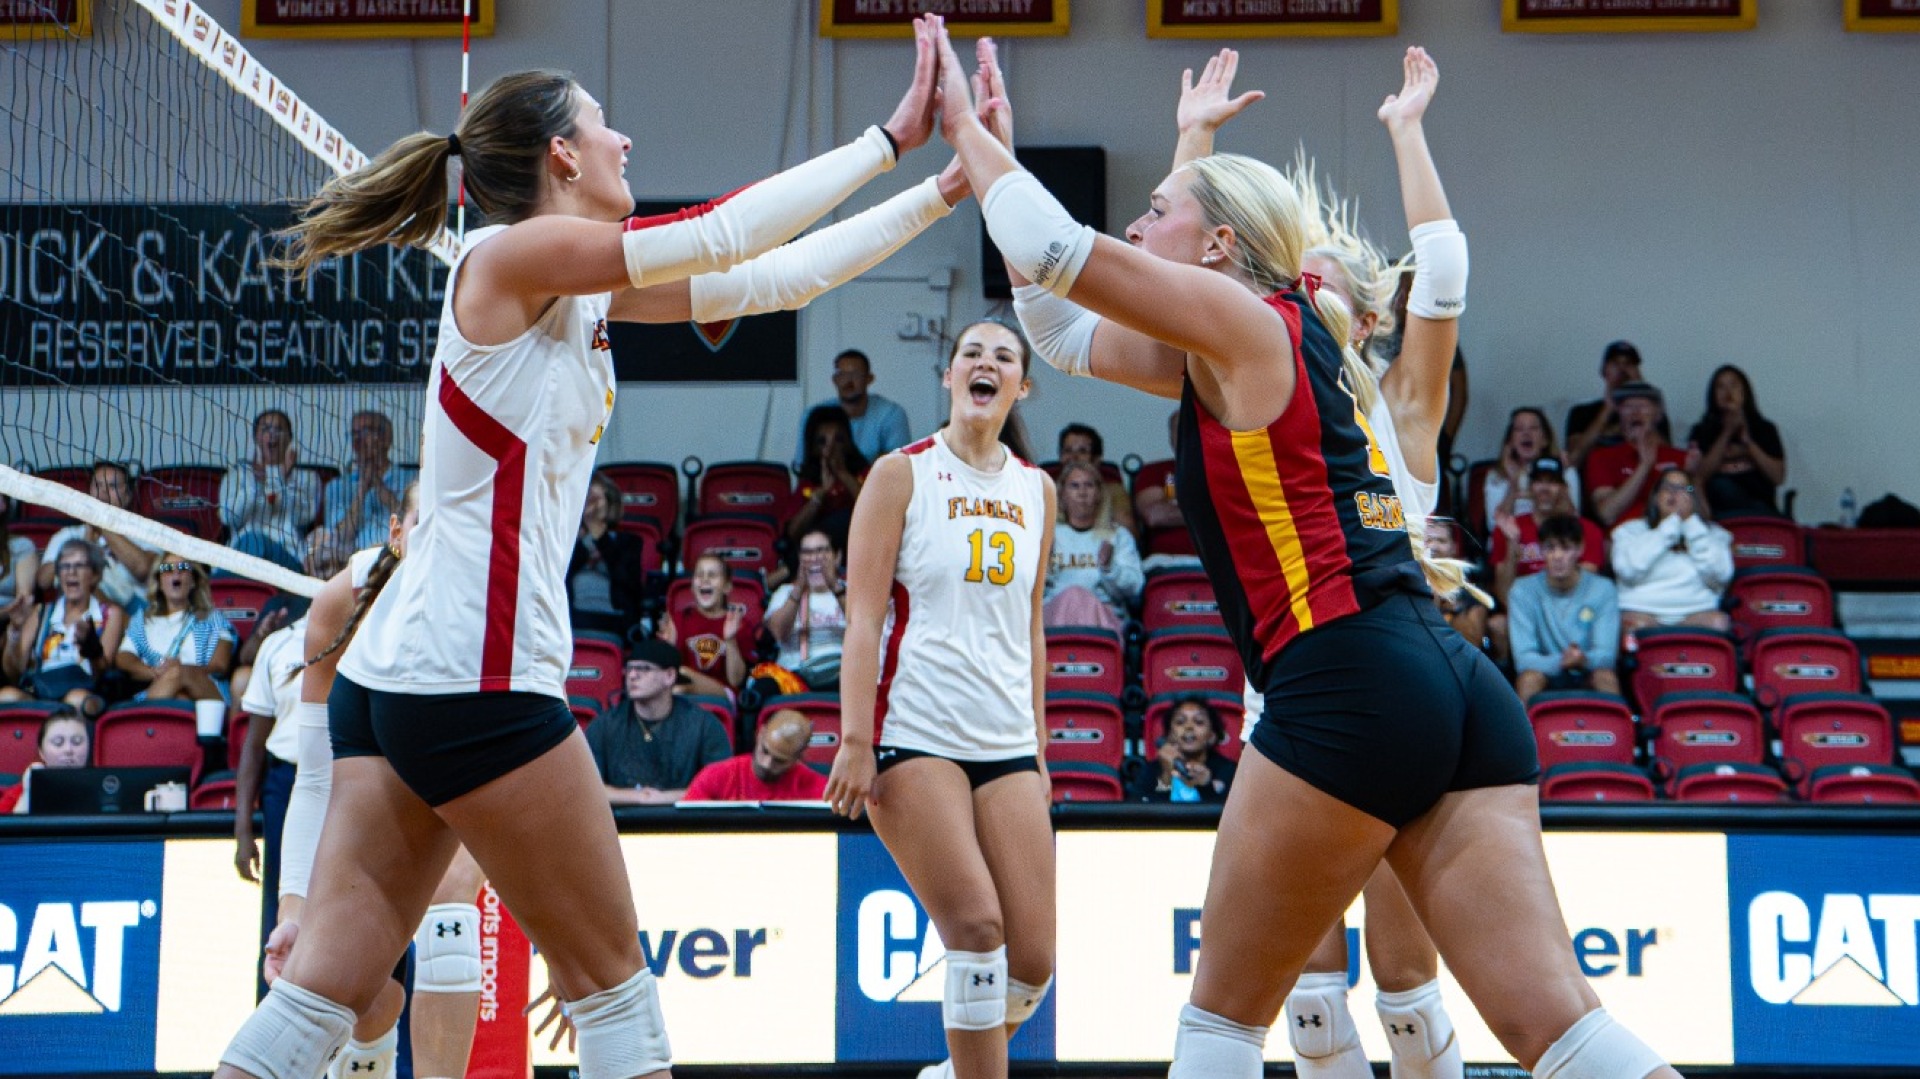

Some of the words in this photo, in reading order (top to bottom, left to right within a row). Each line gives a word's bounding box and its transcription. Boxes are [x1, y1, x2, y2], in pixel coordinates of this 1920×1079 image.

[133, 229, 174, 303] &
[386, 243, 447, 302] KE
[31, 320, 222, 368] RESERVED
[235, 318, 384, 367] SEATING
[399, 318, 440, 367] SE
[1354, 490, 1407, 533] SAIN
[963, 527, 1015, 586] 13
[1747, 889, 1920, 1006] CAT
